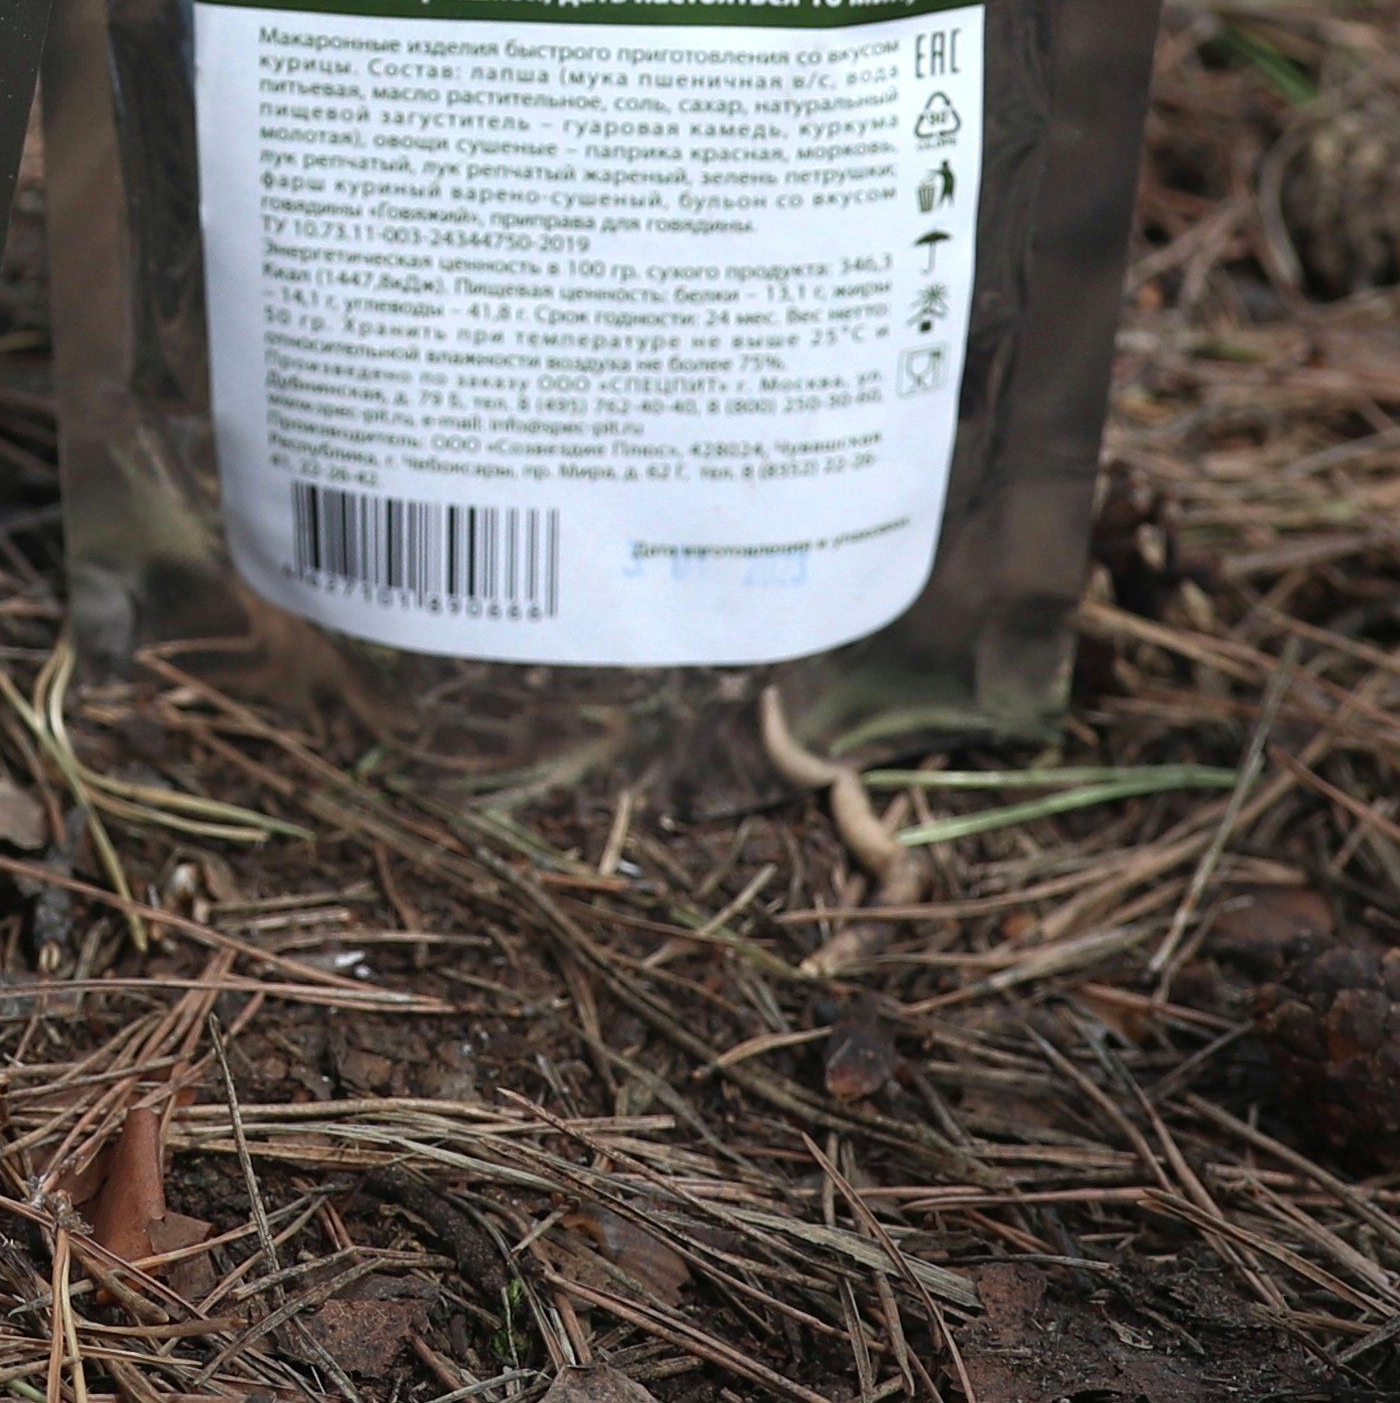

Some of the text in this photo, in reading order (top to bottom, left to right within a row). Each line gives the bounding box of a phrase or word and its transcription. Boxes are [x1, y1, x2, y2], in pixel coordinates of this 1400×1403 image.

[258, 28, 900, 65] Макаронные изделия быстрого приготовления со вкусом
[258, 53, 360, 76] курицы.
[366, 59, 461, 79] Состав:
[469, 66, 550, 83] лапша
[557, 67, 629, 88] (мука
[637, 73, 783, 89] пшеничная
[845, 65, 900, 85] вода
[258, 75, 898, 117] питьевая, масло растительное, соль, сахар, натуральный
[258, 102, 370, 122] пищевой
[380, 109, 530, 130] загуститель
[561, 118, 680, 137] гуаровая
[797, 114, 899, 139] куркума
[371, 133, 449, 153] овощи
[454, 138, 558, 156] сушеные
[584, 144, 682, 162] паприка
[689, 147, 789, 164] красная,
[258, 148, 295, 166] лук
[301, 151, 416, 175] репчатый,
[420, 160, 461, 178] лук
[465, 162, 577, 181] репчатый
[699, 170, 778, 185] зелень
[259, 170, 326, 193] фарш
[333, 178, 442, 198] куриный
[677, 192, 767, 211] бульон
[774, 193, 804, 208] со
[811, 185, 896, 207] вкусом
[262, 215, 284, 234] ТУ
[488, 211, 596, 231] приправа
[599, 216, 641, 233] для
[437, 256, 542, 275] ценность
[568, 259, 606, 277] 100
[644, 265, 720, 282] сухого
[704, 309, 730, 326] 24
[455, 328, 505, 346] при
[535, 373, 591, 391] ООО
